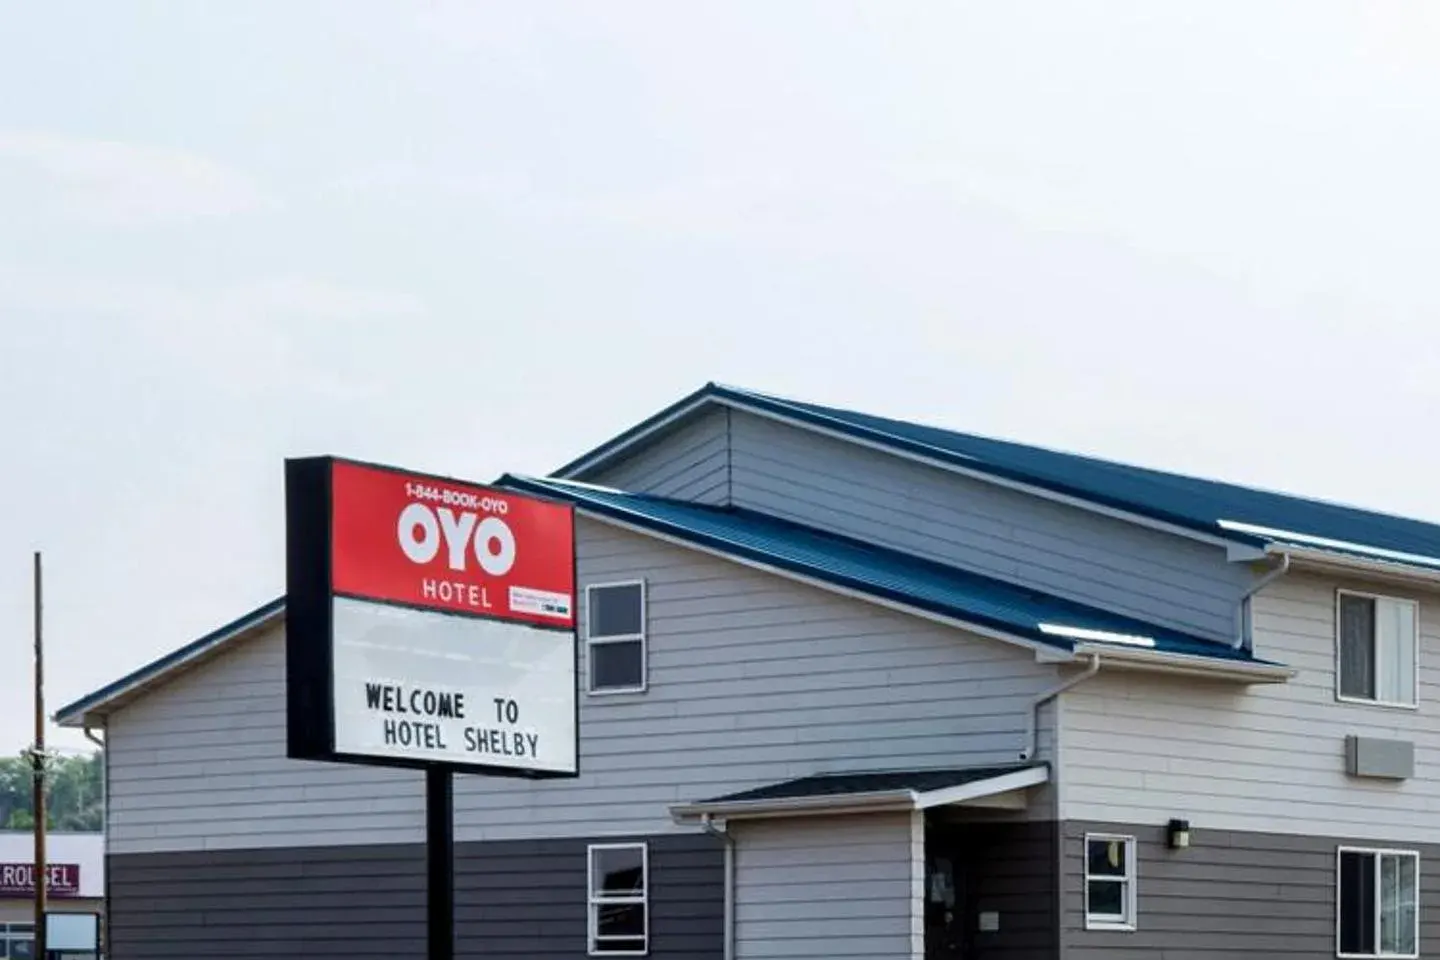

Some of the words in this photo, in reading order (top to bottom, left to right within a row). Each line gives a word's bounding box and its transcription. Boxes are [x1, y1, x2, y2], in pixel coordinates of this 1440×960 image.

[405, 482, 508, 514] 1-844-BOOK-OYO
[397, 502, 516, 576] OYO
[422, 579, 492, 607] HOTEL
[365, 683, 464, 718] WELCOME
[494, 698, 518, 724] TO
[384, 719, 446, 749] HOTEL
[464, 727, 538, 757] SHELBY
